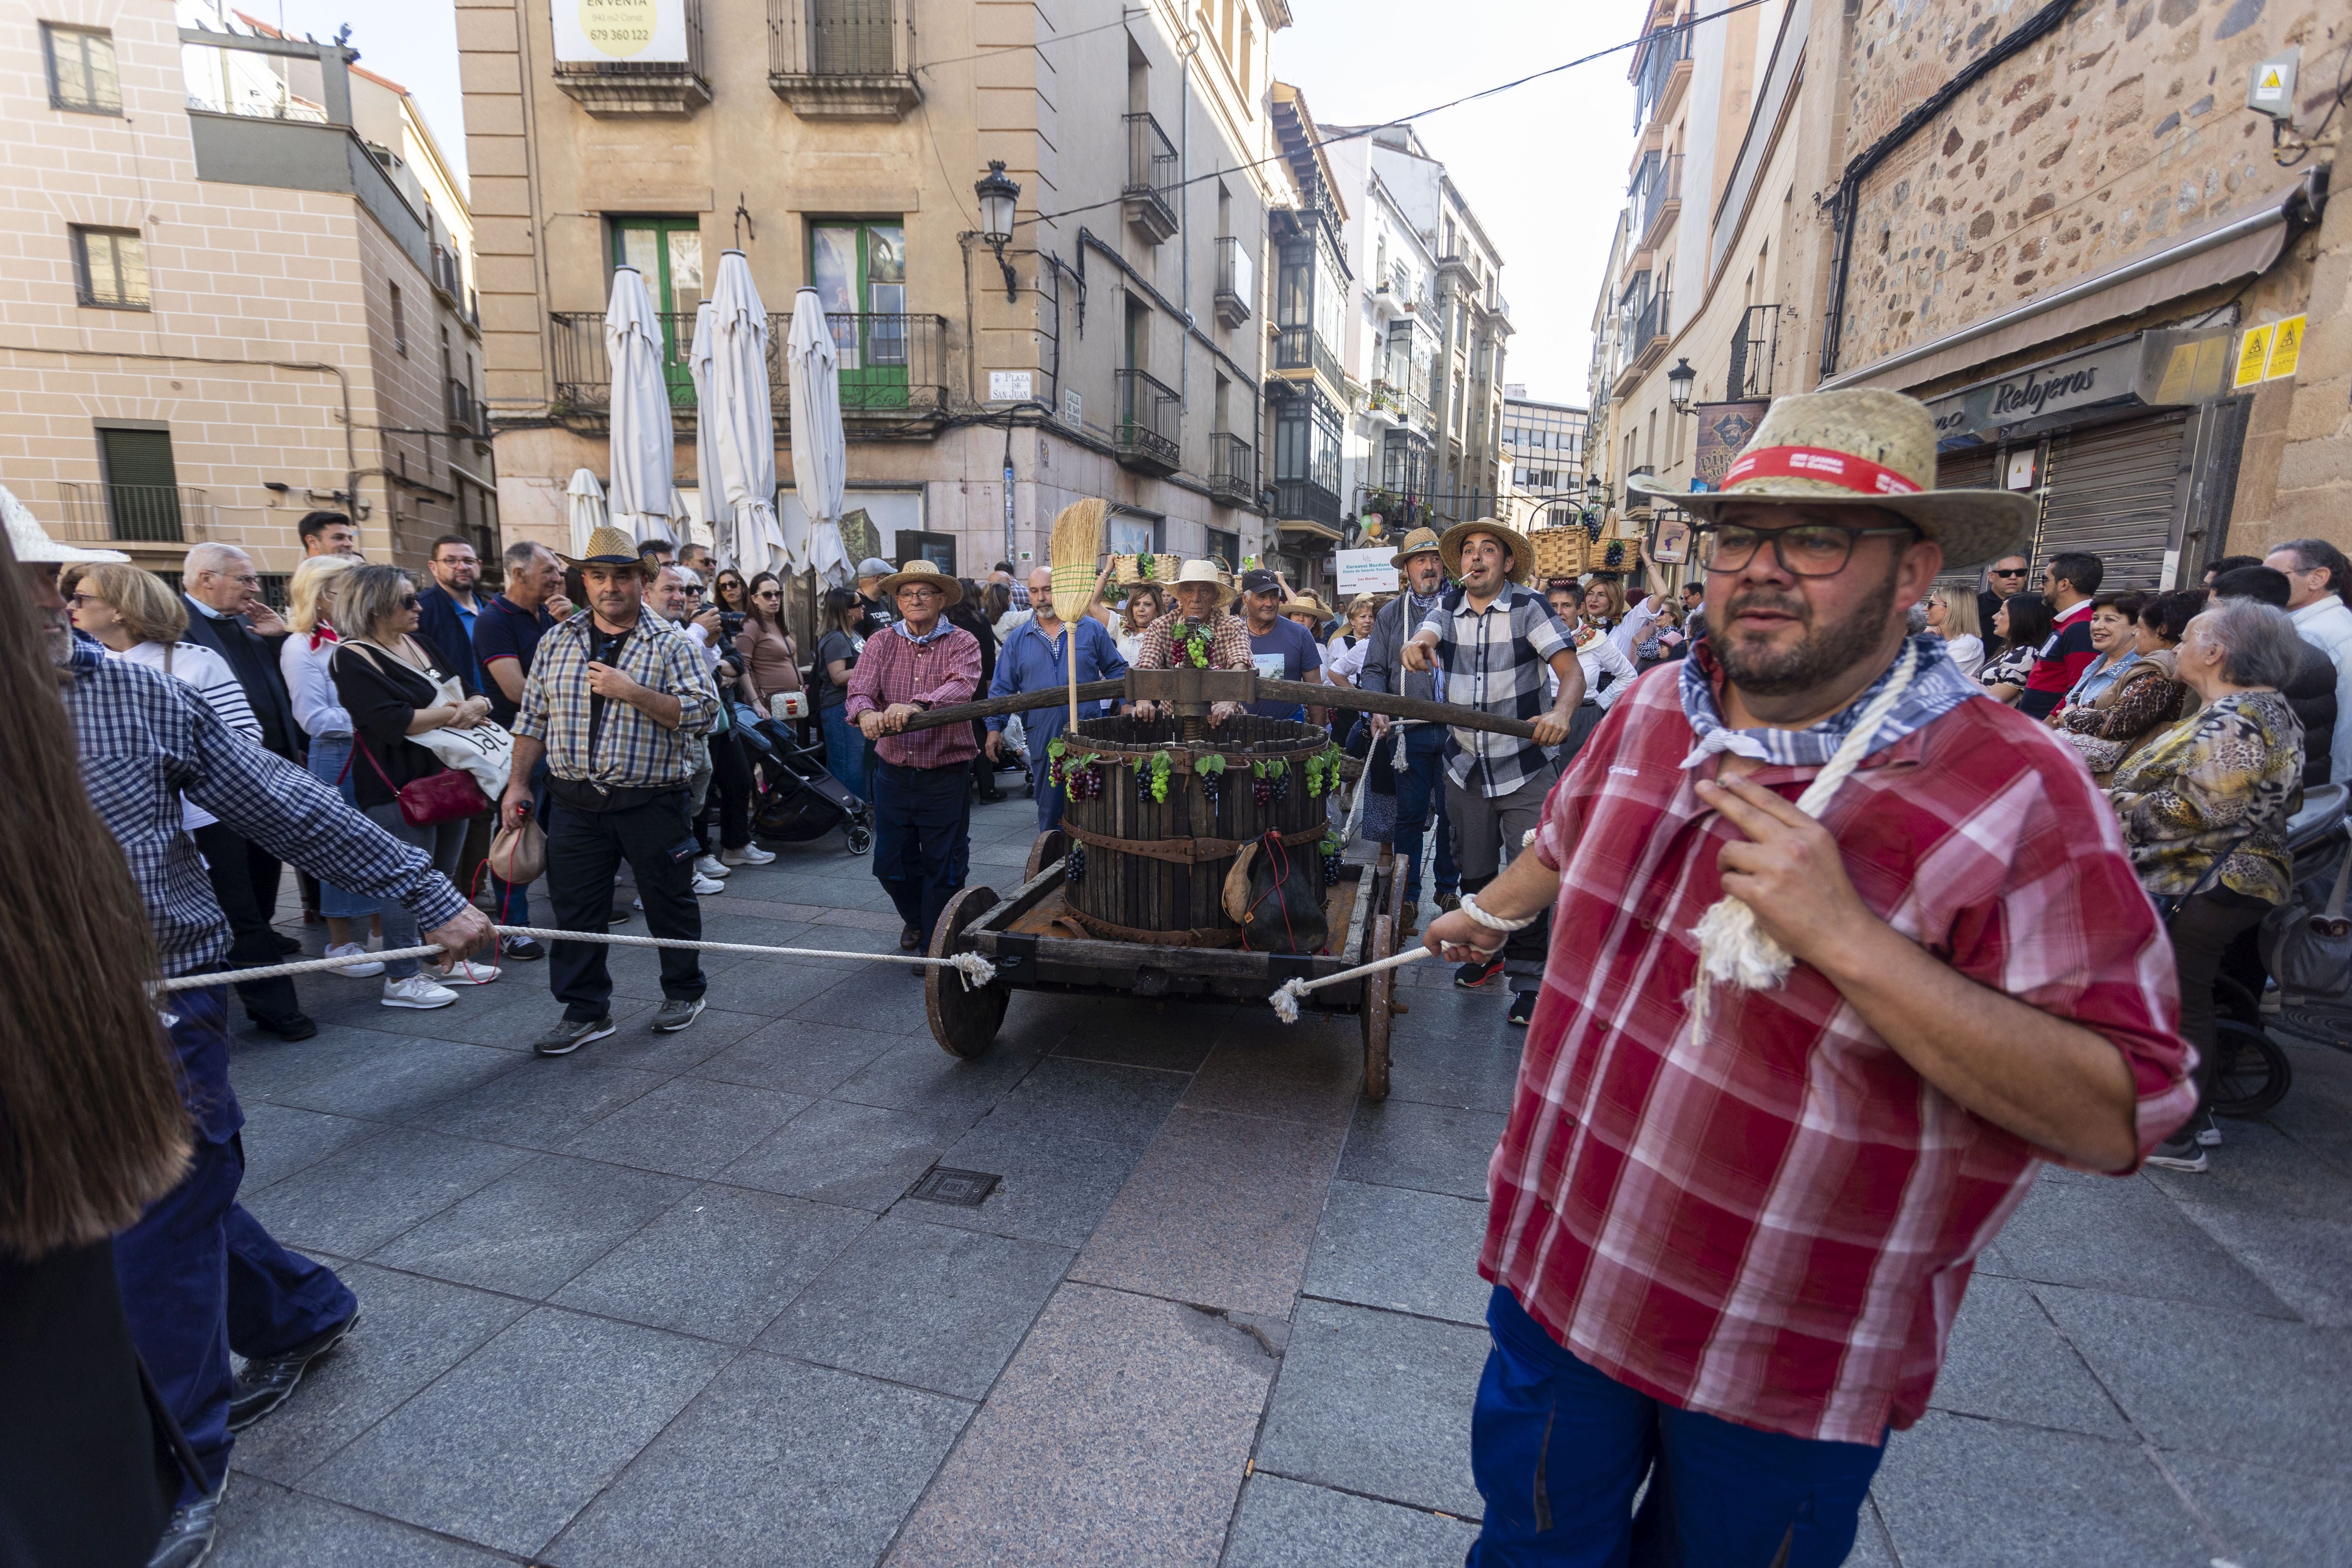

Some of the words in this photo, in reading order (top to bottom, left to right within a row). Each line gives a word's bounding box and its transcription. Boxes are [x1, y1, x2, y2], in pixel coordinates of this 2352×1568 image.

[590, 30, 608, 40] 679
[610, 30, 629, 40] 360
[631, 30, 649, 40] 122
[1005, 373, 1029, 382] PLAZA
[992, 389, 1007, 399] SAN
[1010, 389, 1028, 399] JUAN
[1991, 366, 2098, 415] Relojeros
[1067, 392, 1079, 405] CALLE
[1067, 413, 1079, 425] PEDRO
[1699, 449, 1738, 472] pira
